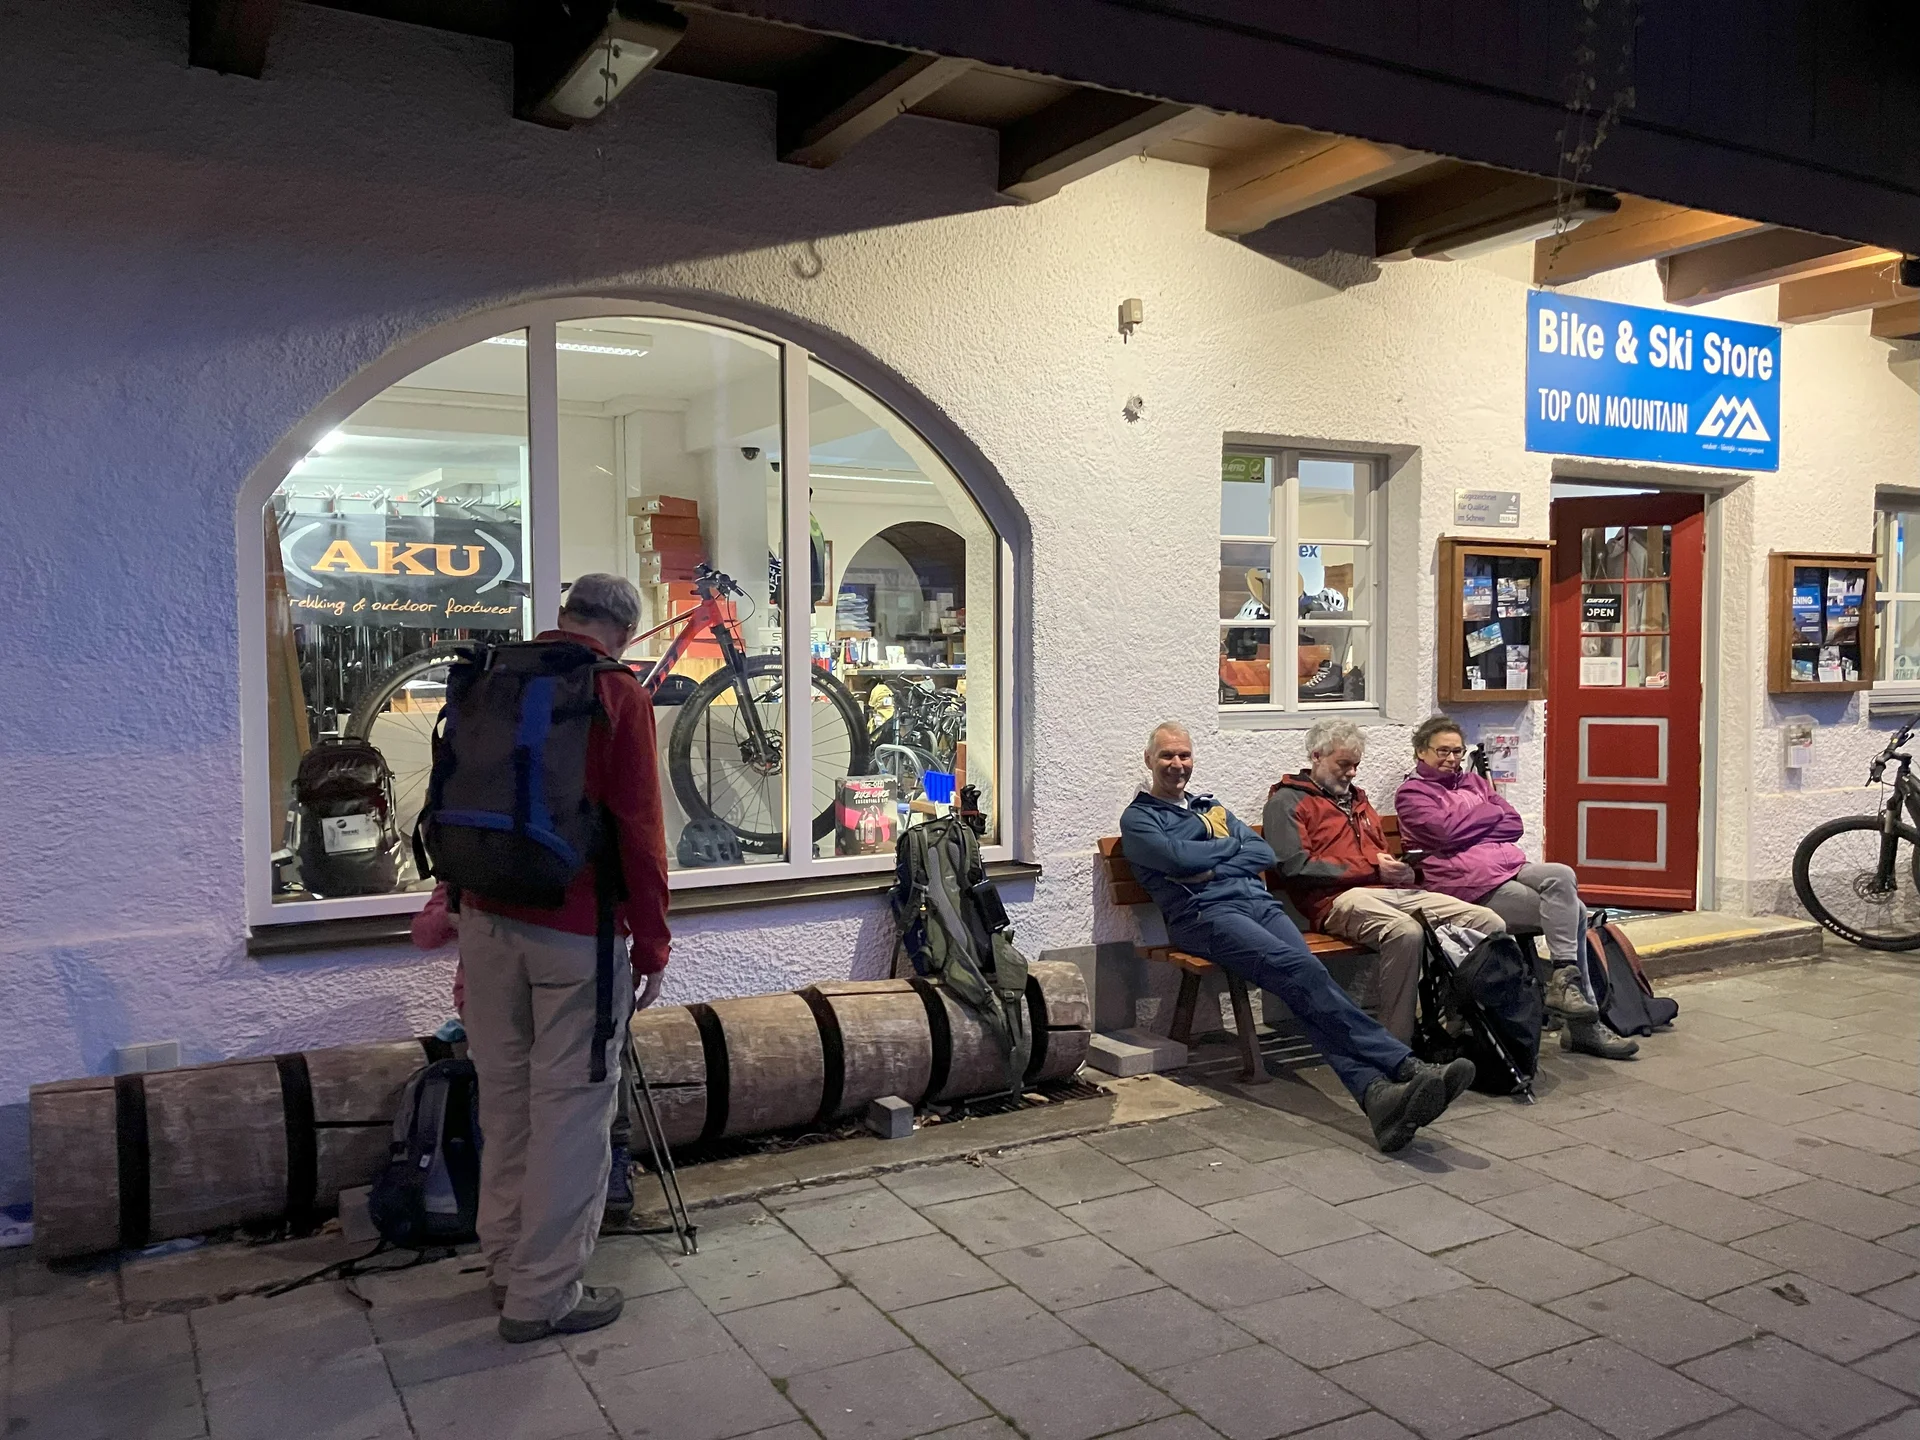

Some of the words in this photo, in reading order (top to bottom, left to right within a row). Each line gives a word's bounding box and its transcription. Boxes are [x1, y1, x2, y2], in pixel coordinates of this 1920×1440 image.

[1538, 309, 1604, 360] Bike
[1615, 320, 1638, 365] &
[1649, 325, 1693, 371] Ski
[1703, 332, 1773, 380] Store
[1538, 388, 1571, 422] TOP
[1576, 392, 1600, 425] ON
[1605, 395, 1688, 434] MOUNTAIN
[310, 539, 486, 577] AKU
[288, 594, 346, 616] rekking
[352, 596, 365, 611] &
[372, 598, 438, 612] outdoor
[445, 598, 518, 619] footwear
[1586, 608, 1614, 617] OPEN
